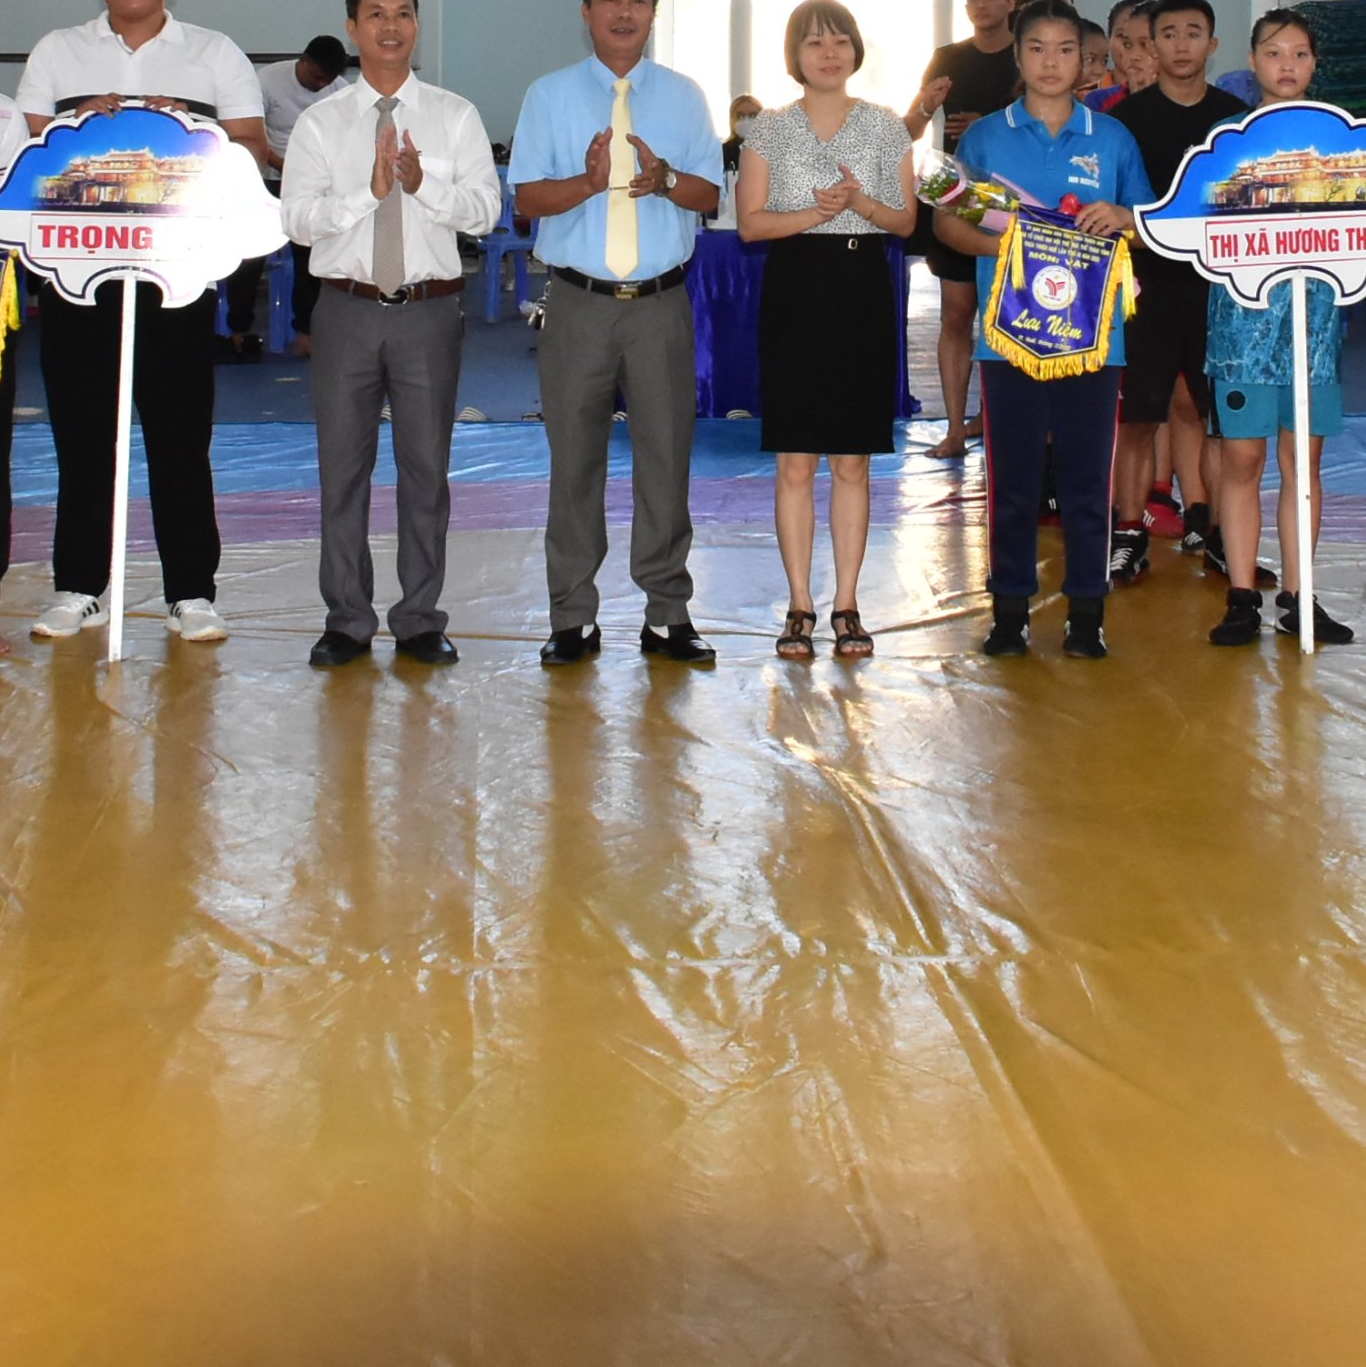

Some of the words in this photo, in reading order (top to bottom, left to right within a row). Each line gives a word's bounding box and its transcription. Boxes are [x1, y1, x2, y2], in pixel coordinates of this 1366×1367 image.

[37, 225, 153, 254] TRỌNG
[1210, 234, 1239, 263] THỊ
[1245, 227, 1270, 256] XÃ
[1275, 227, 1340, 255] HƯƠNG
